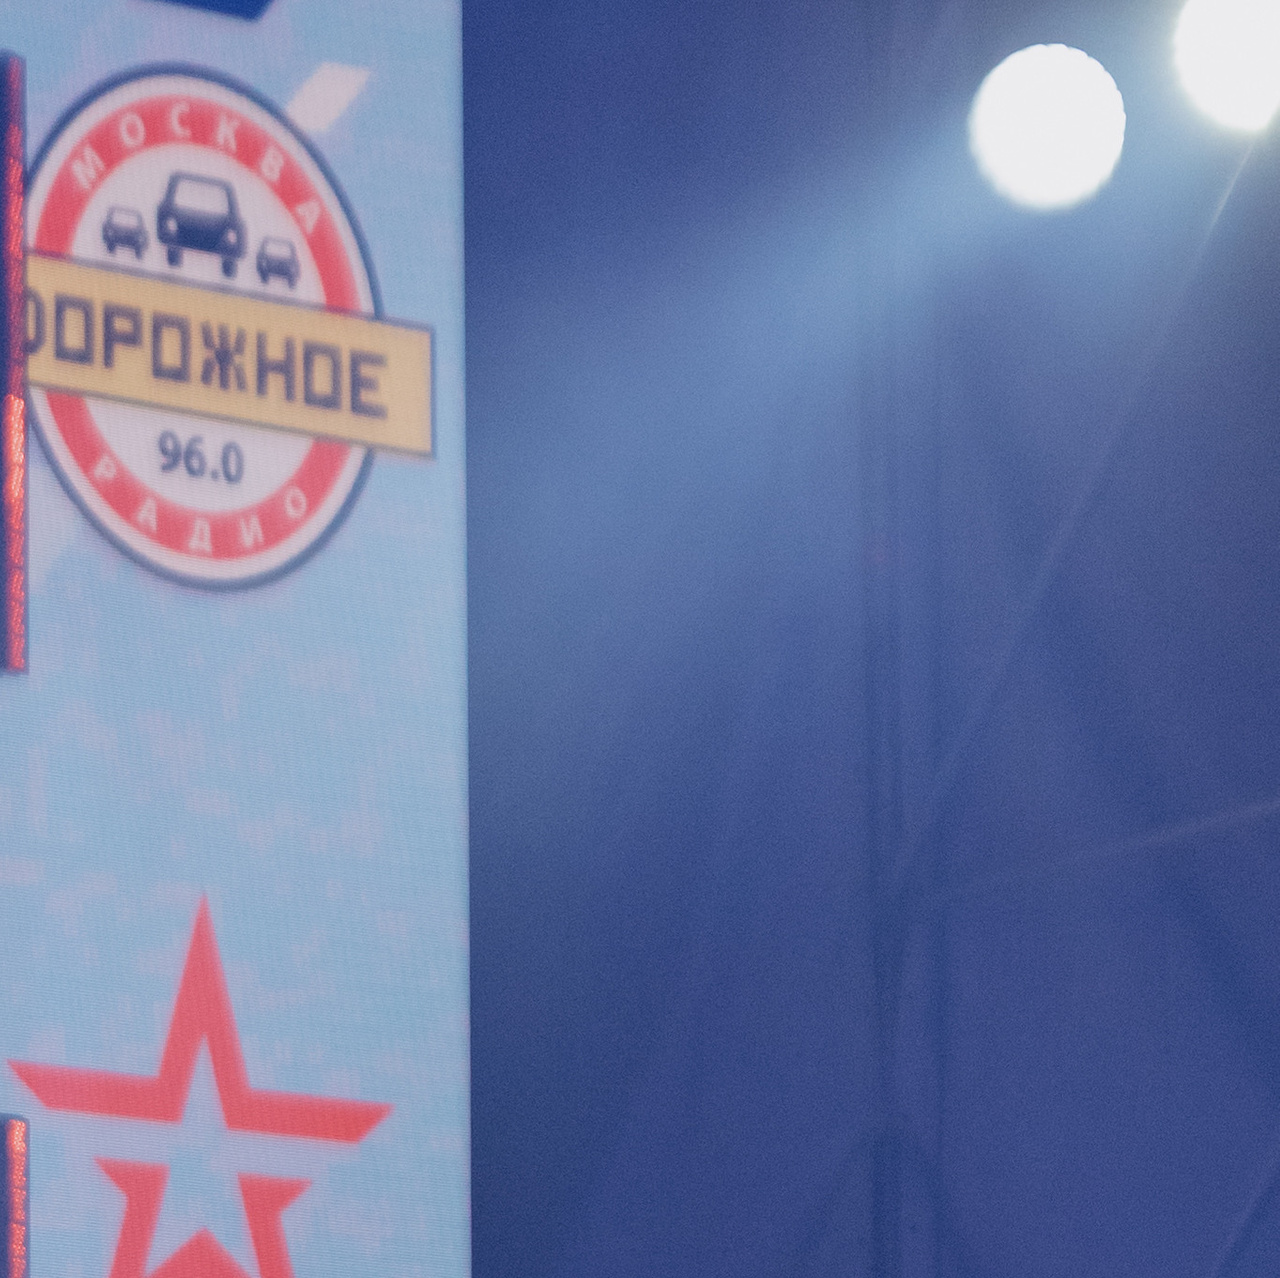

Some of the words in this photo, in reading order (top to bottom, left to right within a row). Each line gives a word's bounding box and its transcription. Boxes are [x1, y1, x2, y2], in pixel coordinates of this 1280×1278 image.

[70, 101, 321, 235] МОСКВА
[91, 452, 307, 556] РАДИО
[158, 429, 244, 485] 96.0
